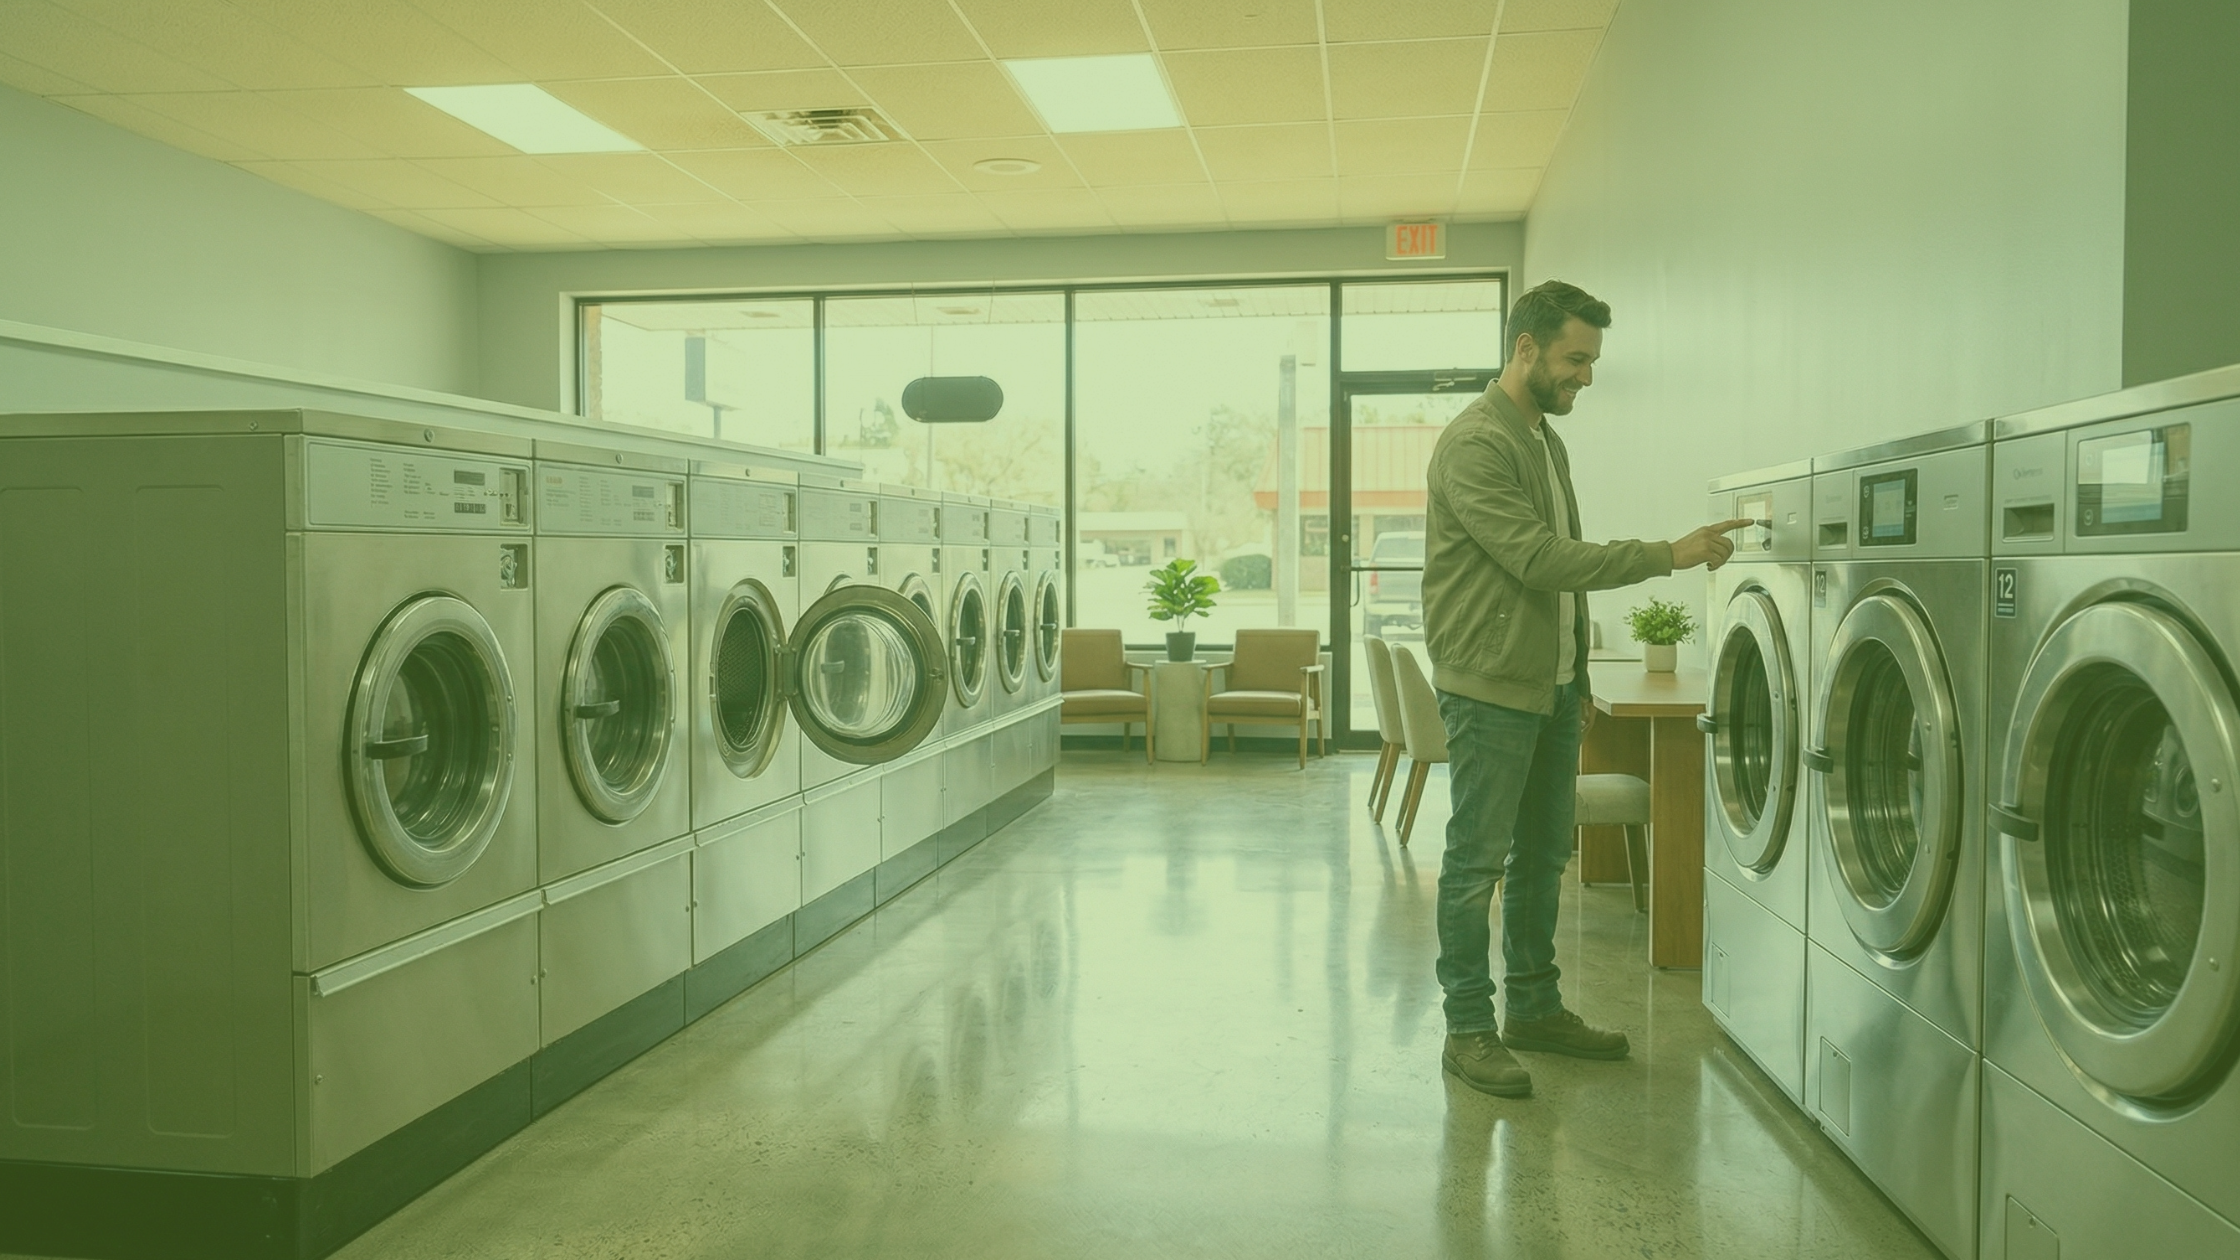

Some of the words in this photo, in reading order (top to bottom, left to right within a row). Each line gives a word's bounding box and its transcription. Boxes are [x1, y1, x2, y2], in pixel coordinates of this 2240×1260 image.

[1396, 225, 1438, 255] EXIT
[1816, 574, 1825, 593] 12
[1999, 573, 2014, 599] 12
